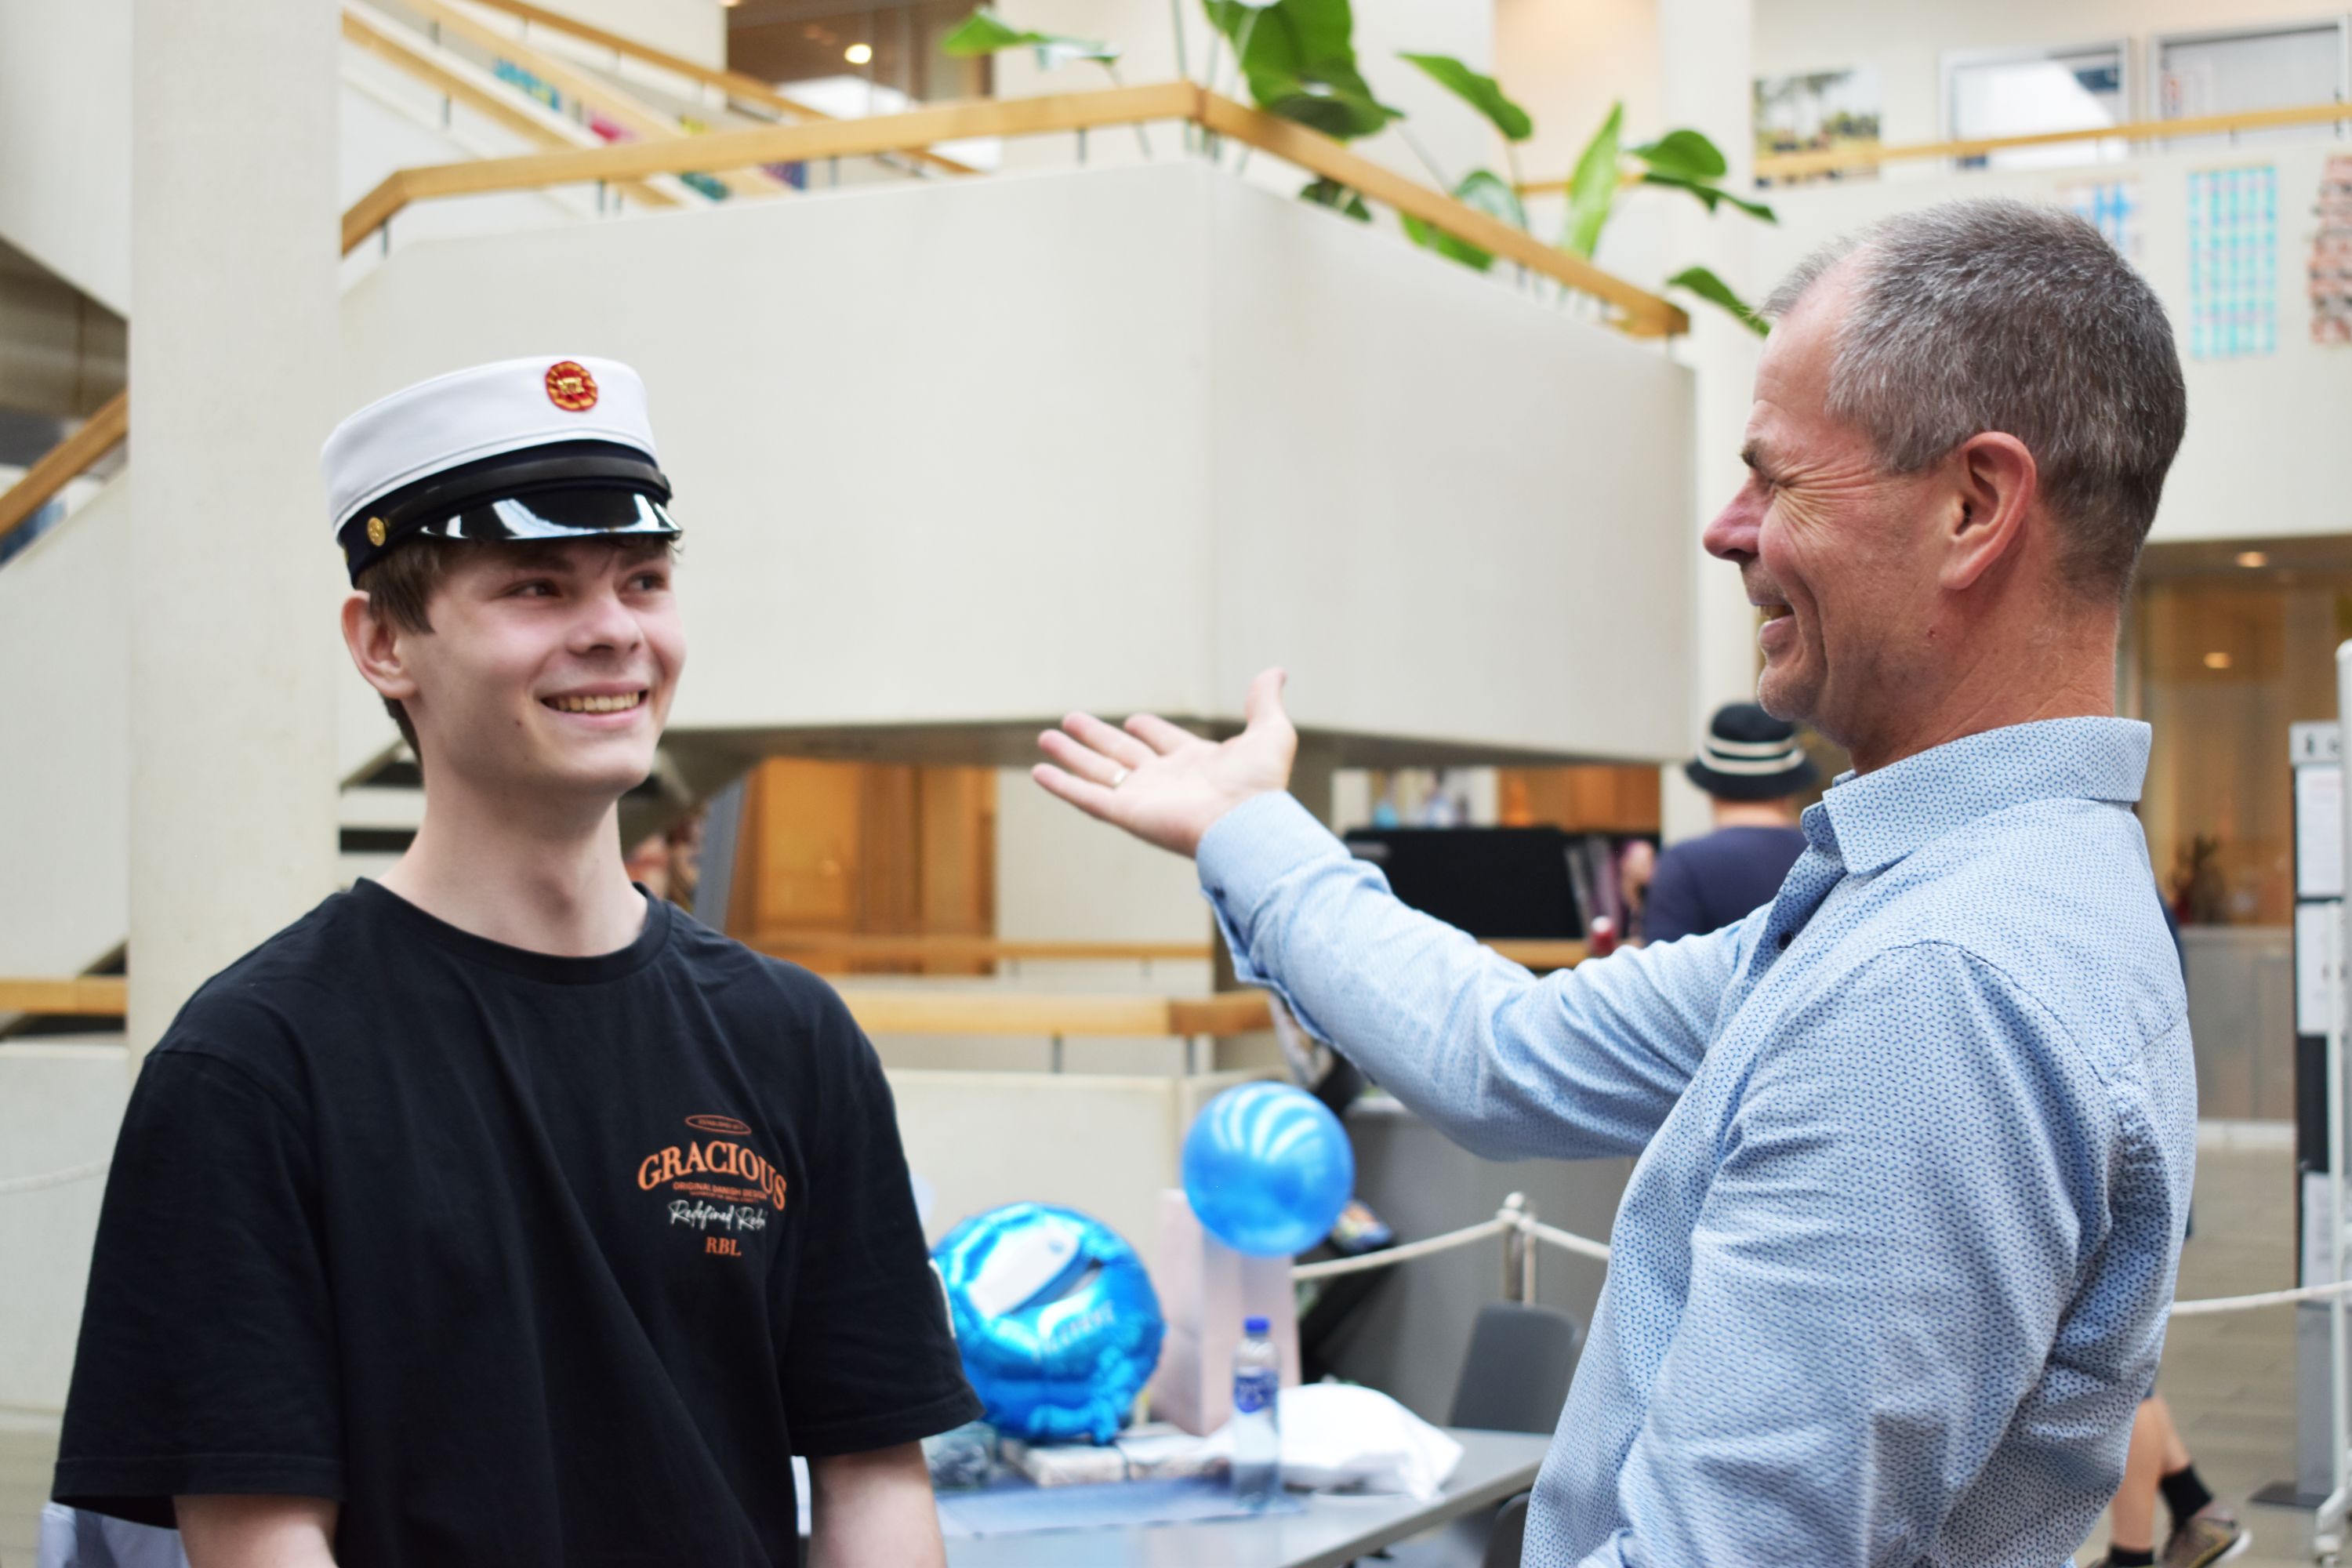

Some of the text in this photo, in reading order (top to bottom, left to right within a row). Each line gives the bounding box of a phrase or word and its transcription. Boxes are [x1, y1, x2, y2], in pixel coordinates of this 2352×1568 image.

[637, 1140, 786, 1210] GRACIOUS
[673, 1181, 710, 1192] ORIGINAL
[712, 1184, 741, 1196] DANISH
[706, 1236, 742, 1257] RBL
